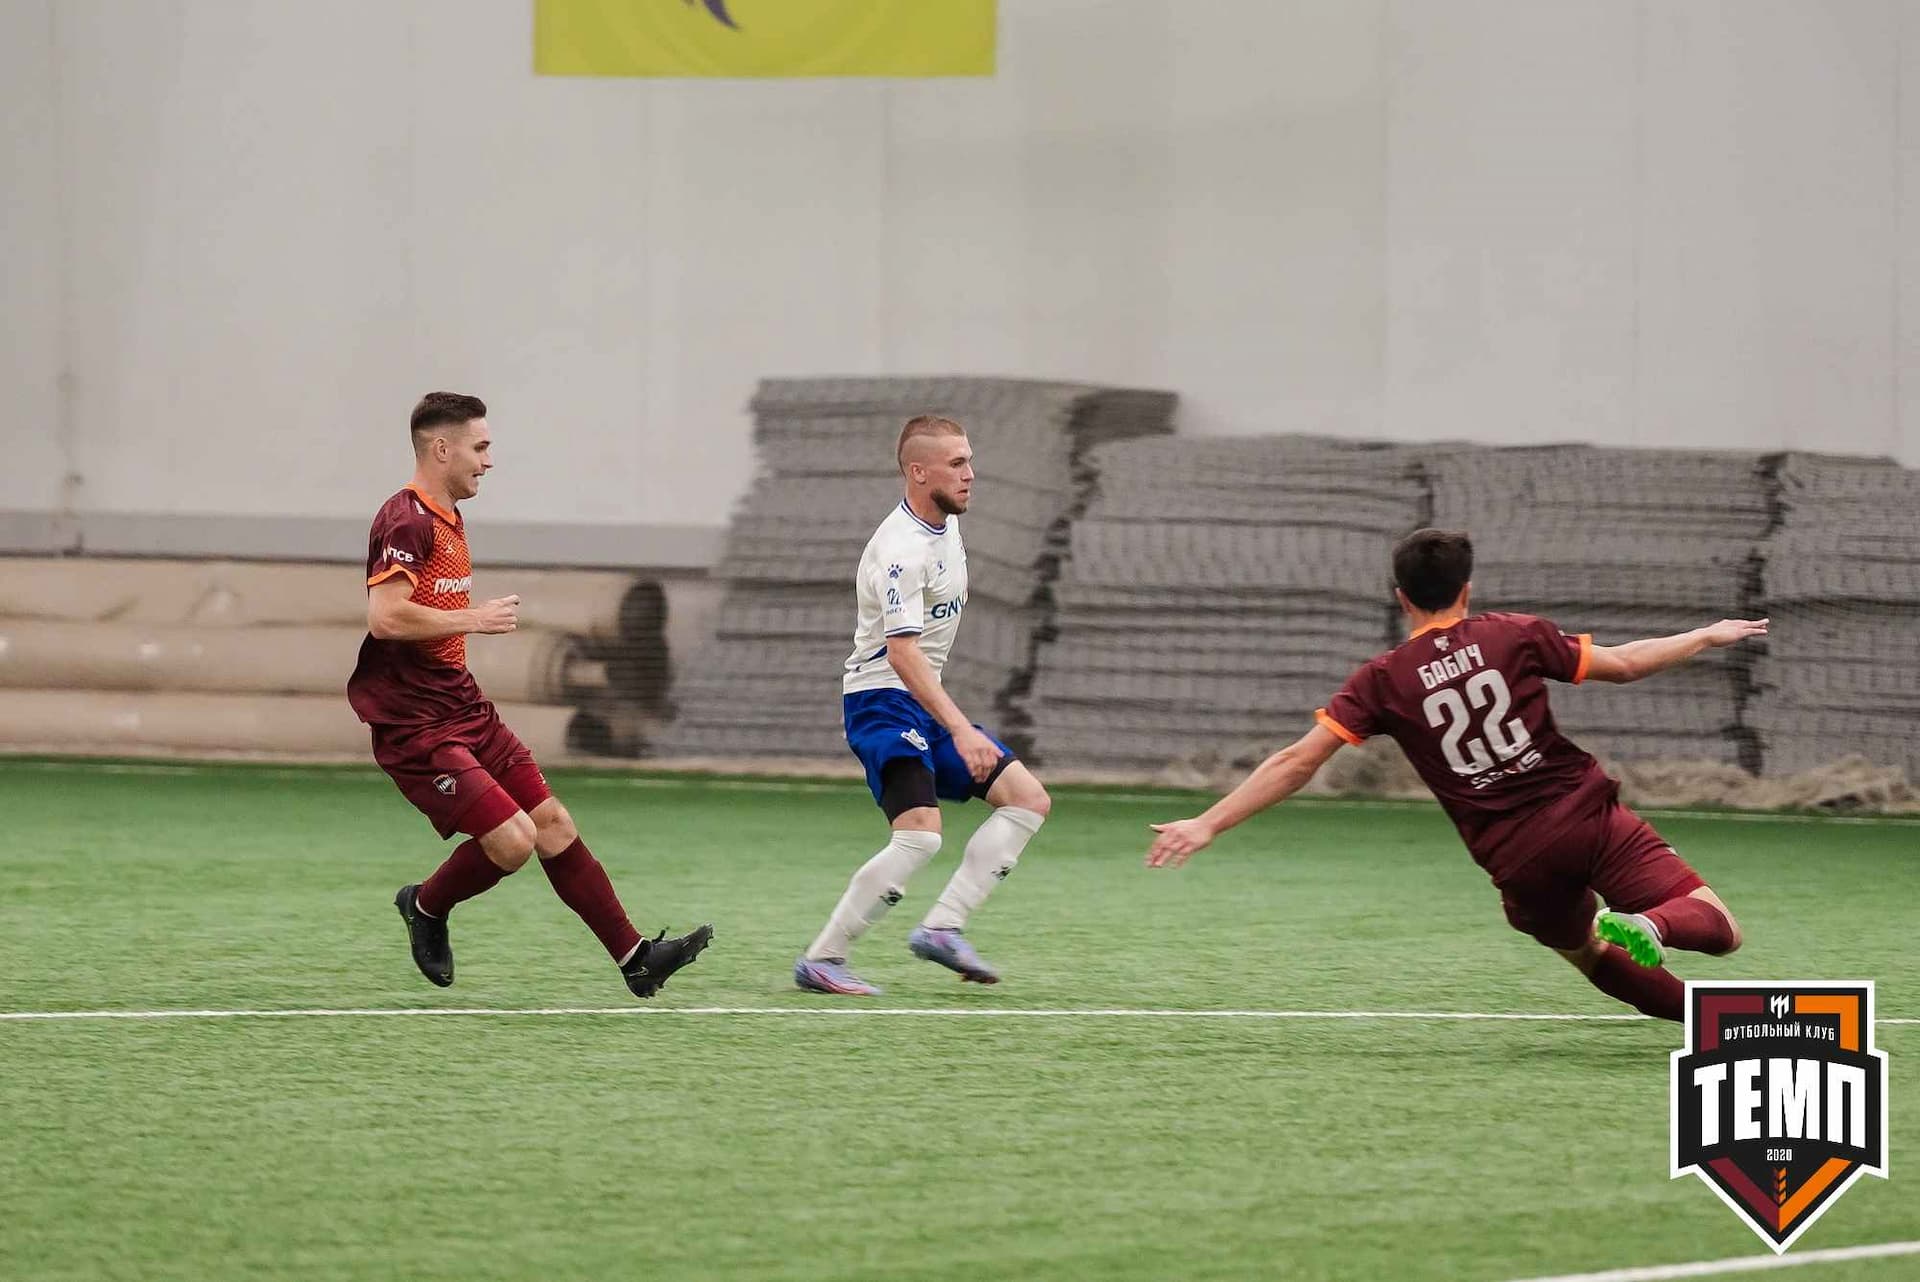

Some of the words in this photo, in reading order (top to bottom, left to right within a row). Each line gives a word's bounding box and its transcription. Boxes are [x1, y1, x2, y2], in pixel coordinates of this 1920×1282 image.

[388, 546, 414, 563] ПСБ
[1417, 643, 1486, 690] БАБИЧ
[1422, 668, 1532, 776] 22
